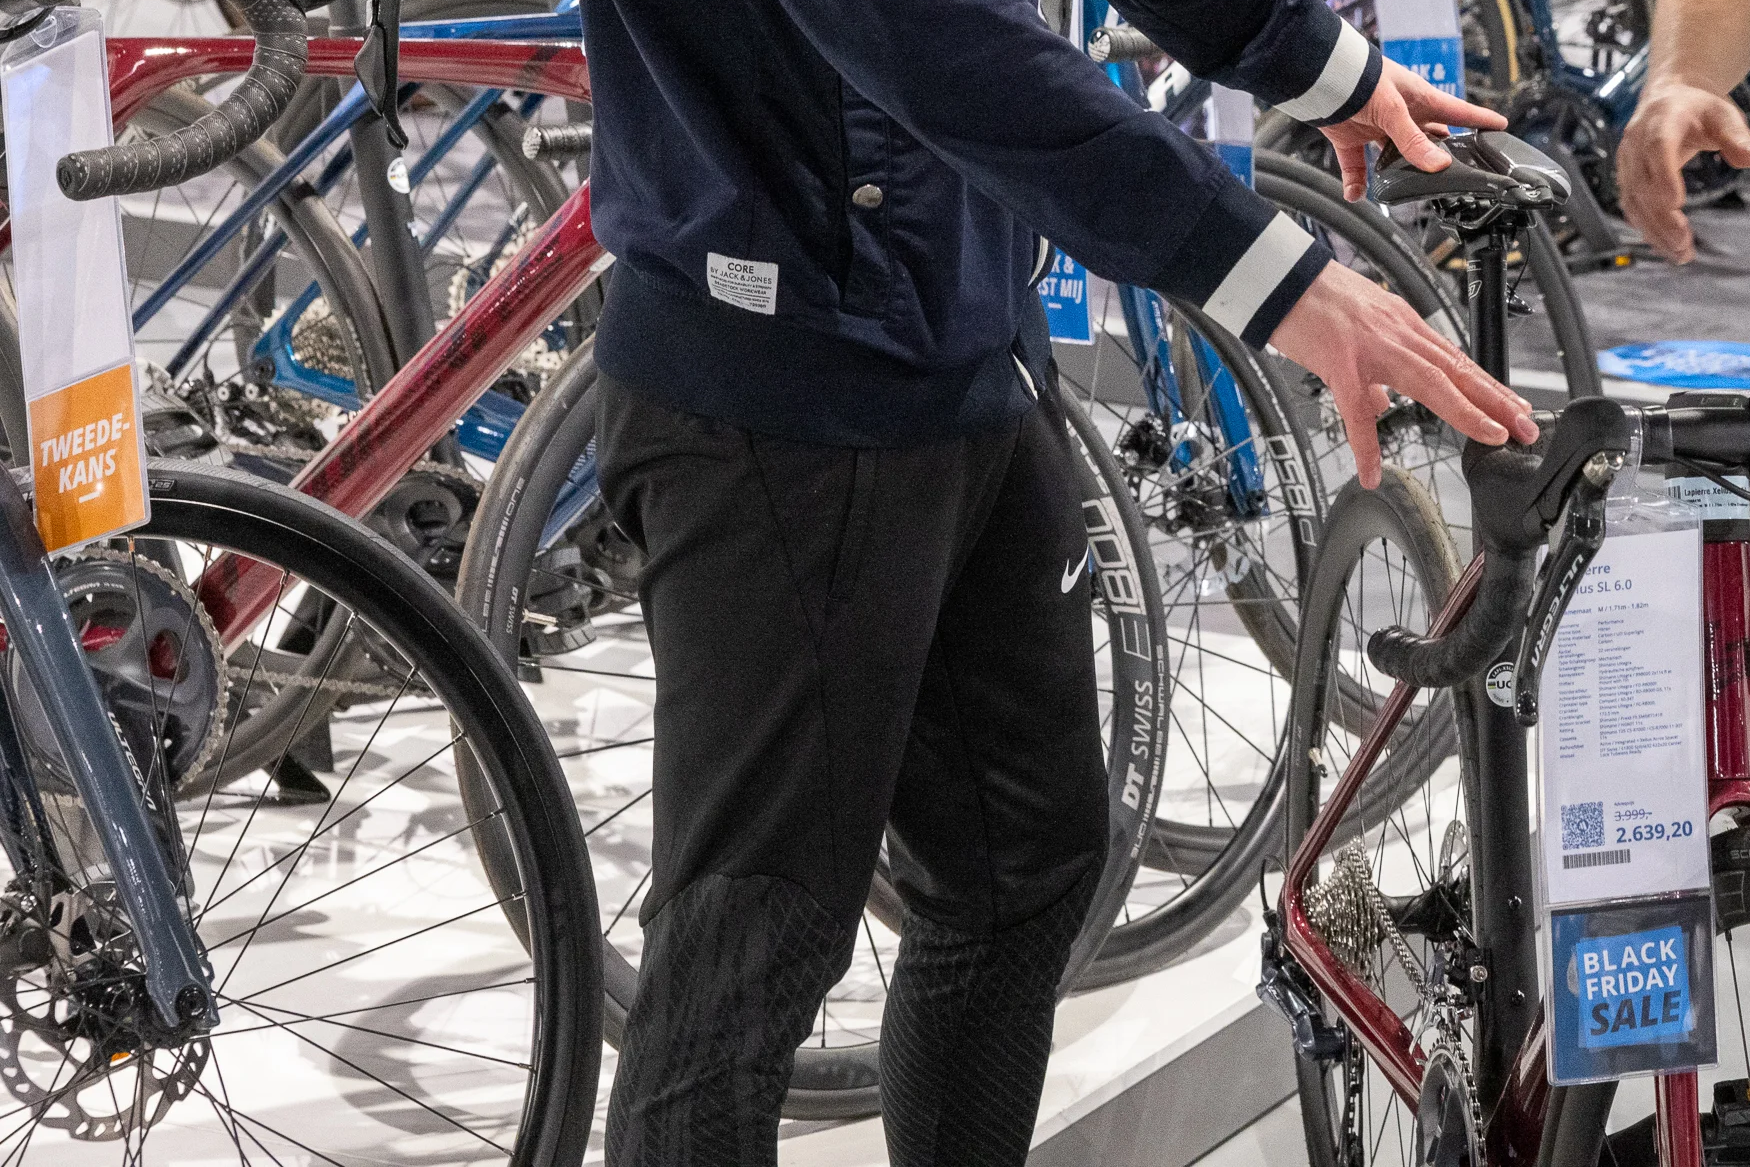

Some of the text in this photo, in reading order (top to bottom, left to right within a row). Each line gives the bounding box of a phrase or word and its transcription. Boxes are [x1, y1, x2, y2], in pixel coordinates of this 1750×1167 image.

[710, 266, 719, 274] BY
[720, 270, 739, 281] JACK
[746, 275, 772, 285] JONES
[727, 262, 755, 274] CORE
[1060, 278, 1083, 304] MIJ
[40, 412, 130, 467] TWEEDE-
[58, 448, 117, 494] KANS
[1684, 488, 1710, 498] Lapierre
[1585, 564, 1611, 576] erre
[1597, 581, 1611, 593] SL
[1614, 579, 1632, 591] 6.0
[505, 586, 519, 635] DT SWISS
[1131, 680, 1153, 761] SWISS
[1120, 763, 1146, 812] DT
[1616, 820, 1693, 844] 2.639,20
[1583, 938, 1677, 975] BLACK
[1586, 963, 1678, 1001] FRIDAY
[1590, 990, 1681, 1036] SALE
